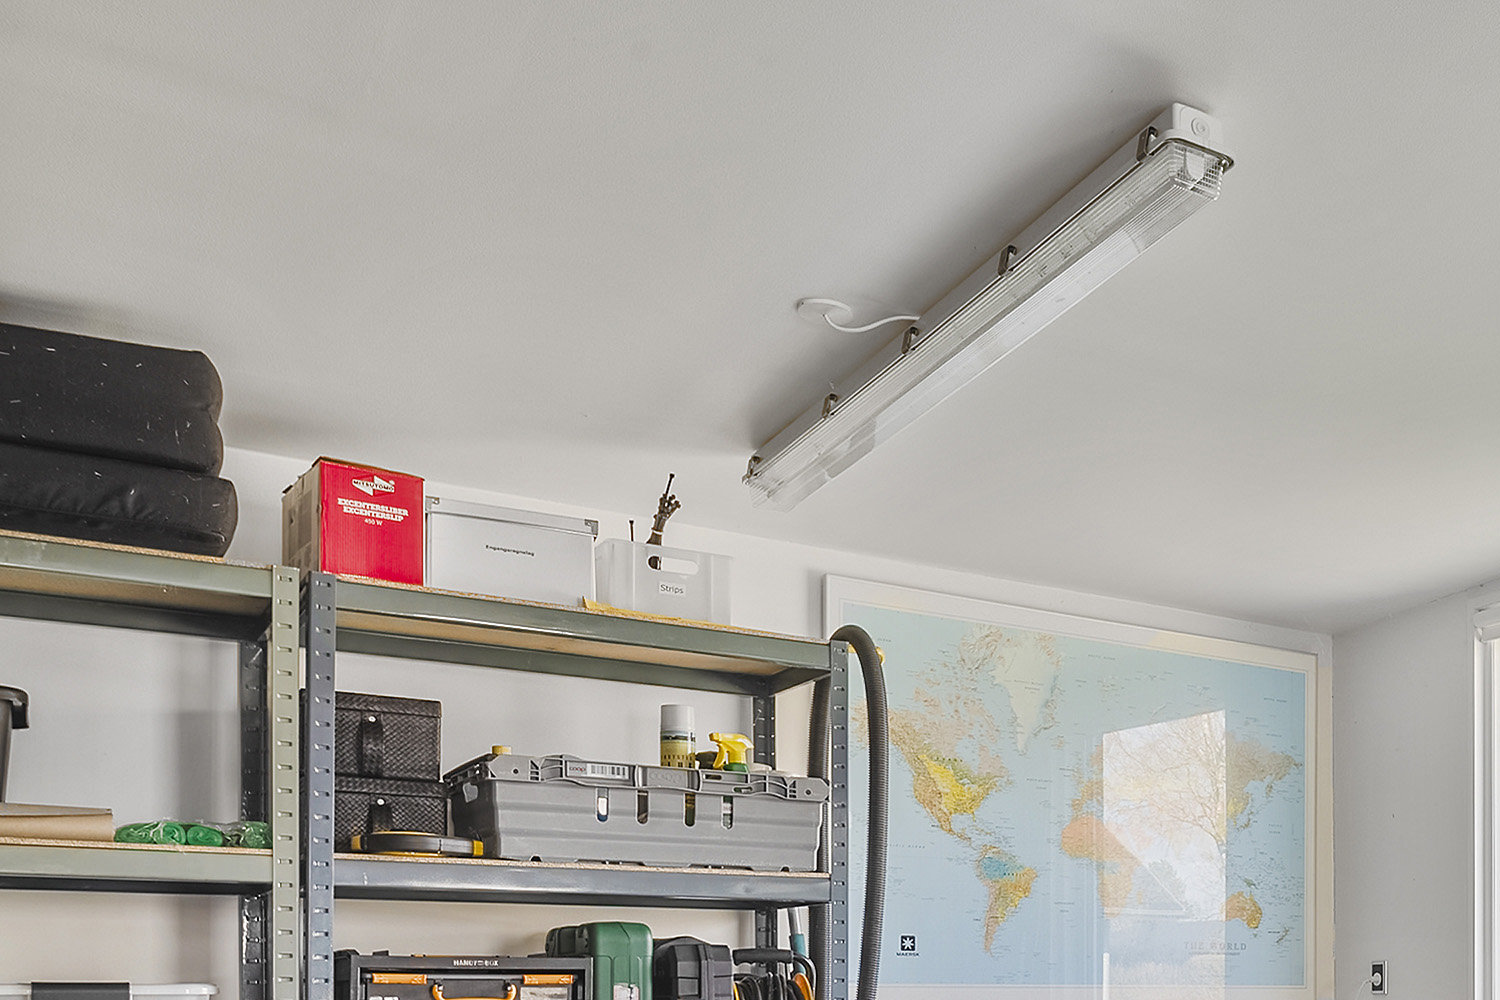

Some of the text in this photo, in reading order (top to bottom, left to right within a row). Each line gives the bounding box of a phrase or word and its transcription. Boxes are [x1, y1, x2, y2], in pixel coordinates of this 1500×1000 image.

[342, 505, 404, 522] EXCENTERSLIP
[660, 583, 685, 595] Strips
[453, 959, 499, 967] HANDY BOX
